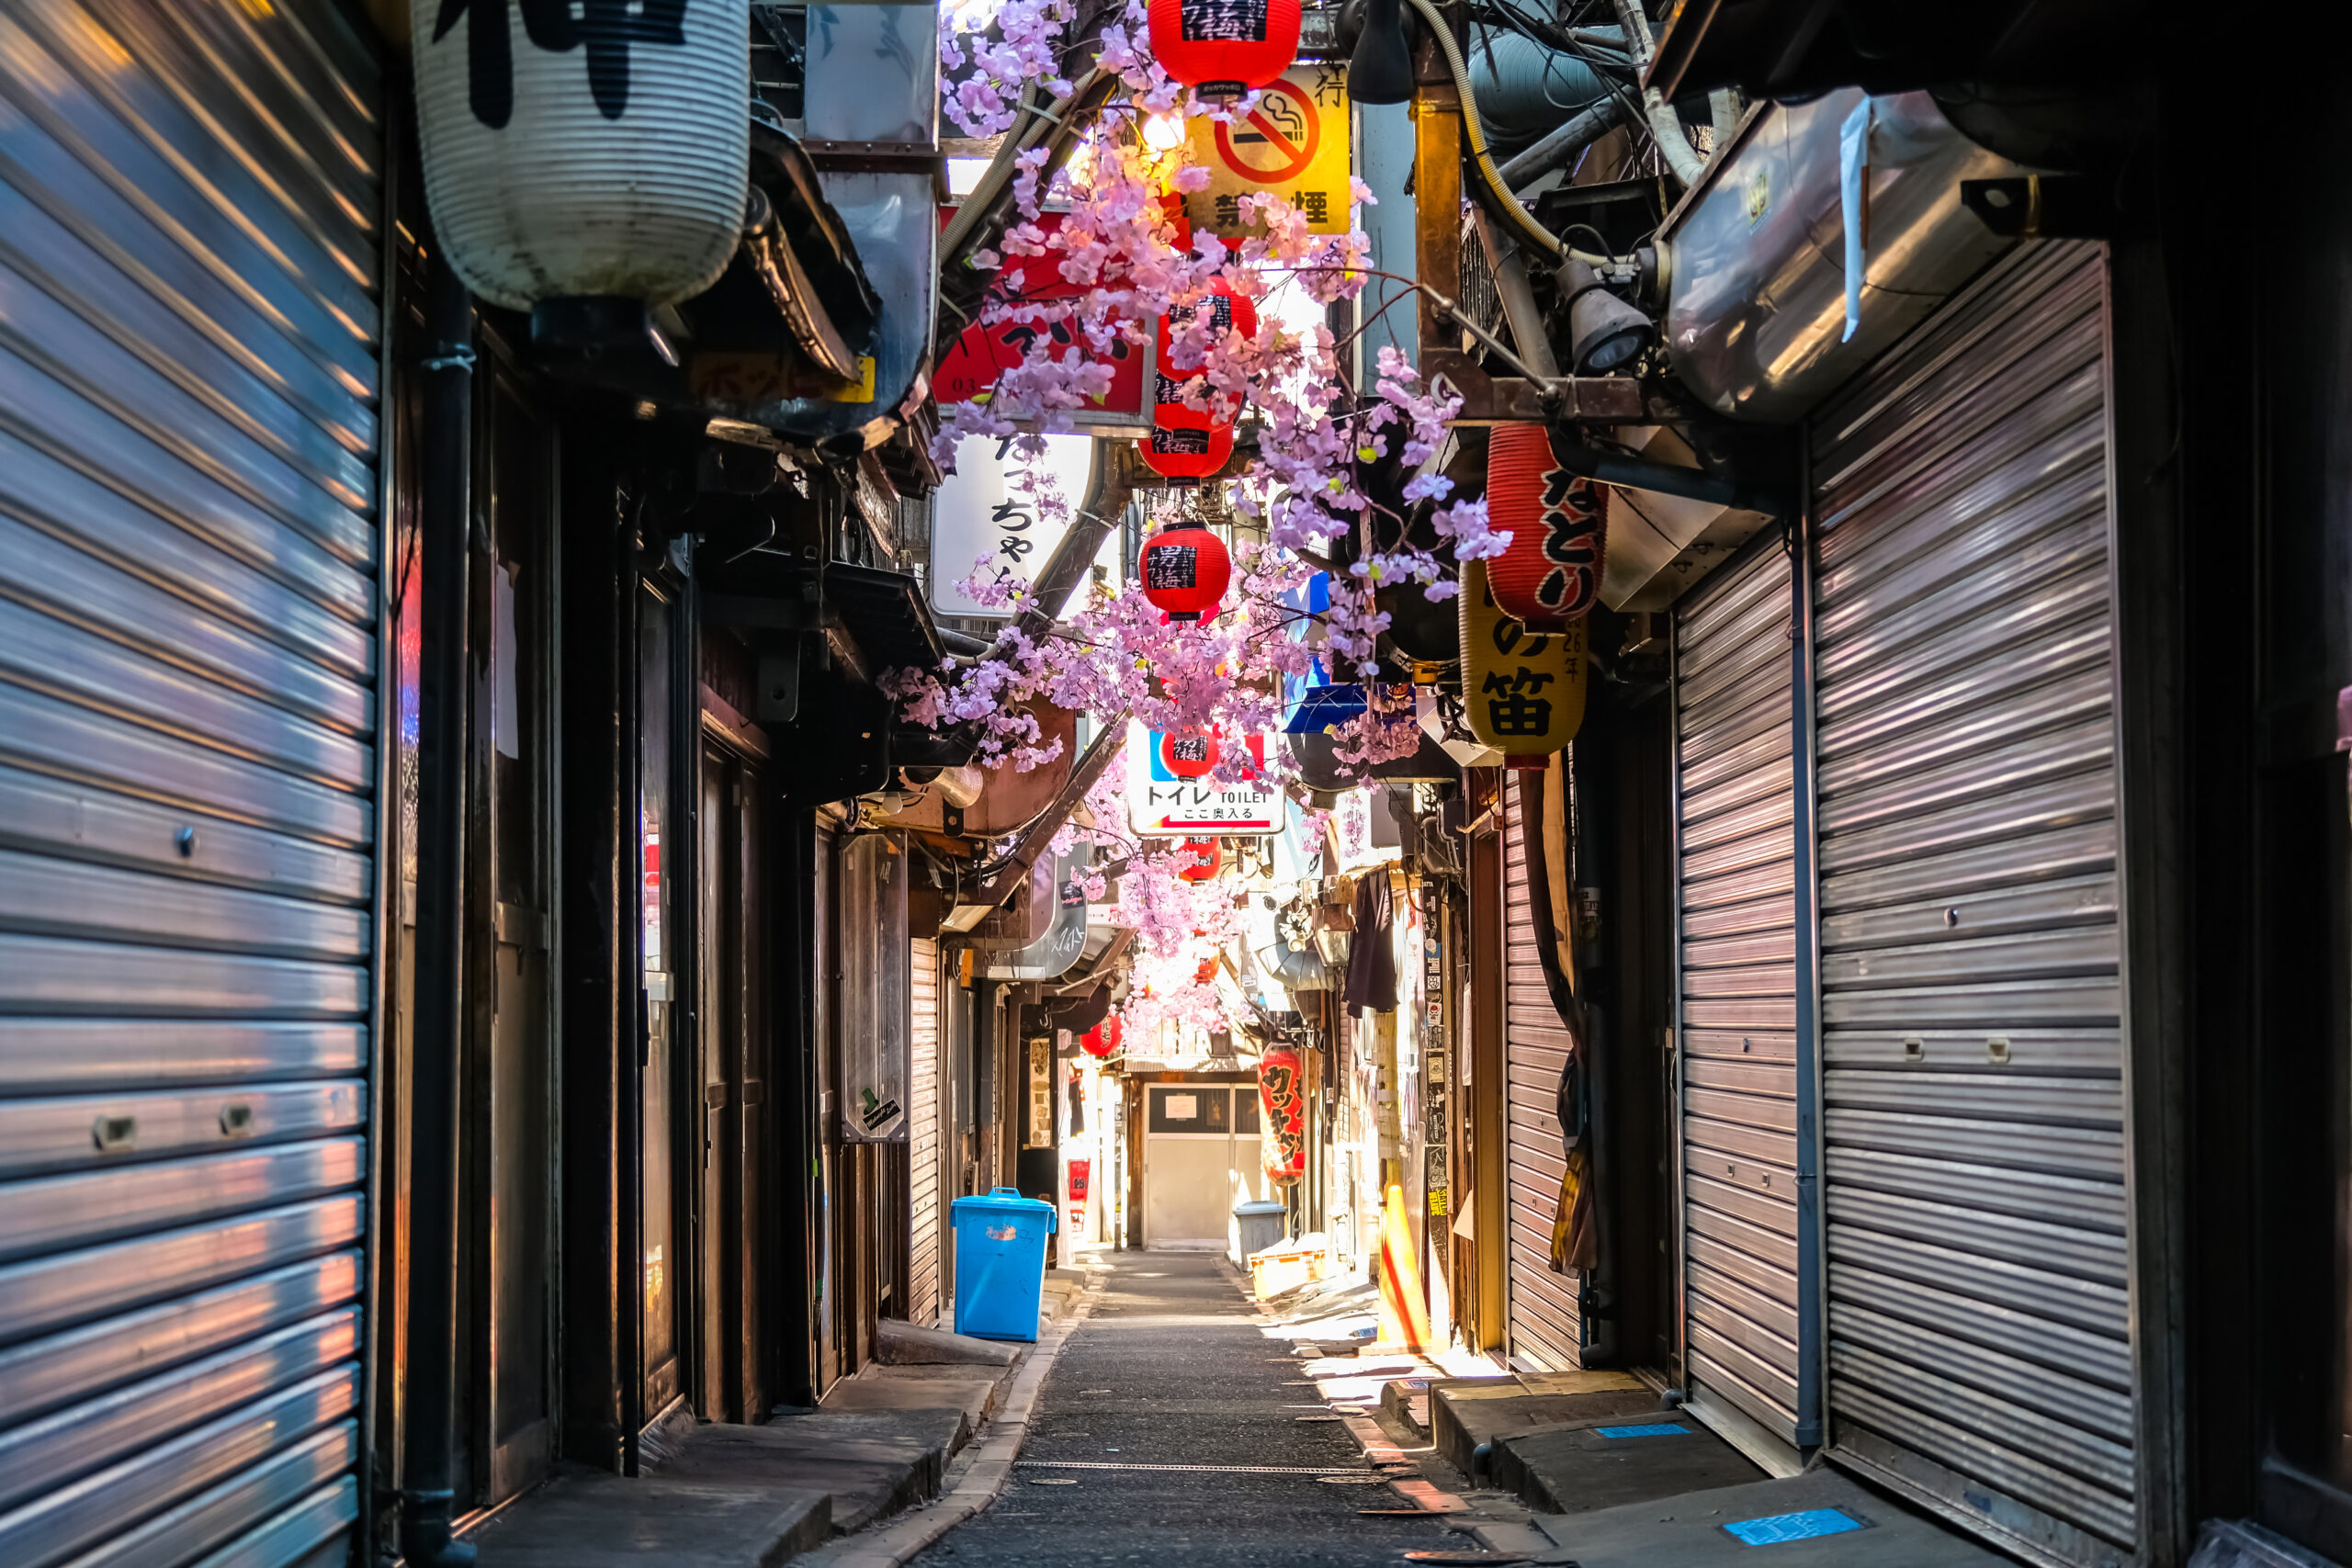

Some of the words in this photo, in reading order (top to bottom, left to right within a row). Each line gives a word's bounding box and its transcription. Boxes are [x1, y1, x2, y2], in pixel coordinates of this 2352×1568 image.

[1159, 545, 1182, 589] 男梅
[1148, 785, 1211, 807] トイレ
[1220, 792, 1266, 804] TOILET
[1184, 807, 1253, 819] ここ奥入る
